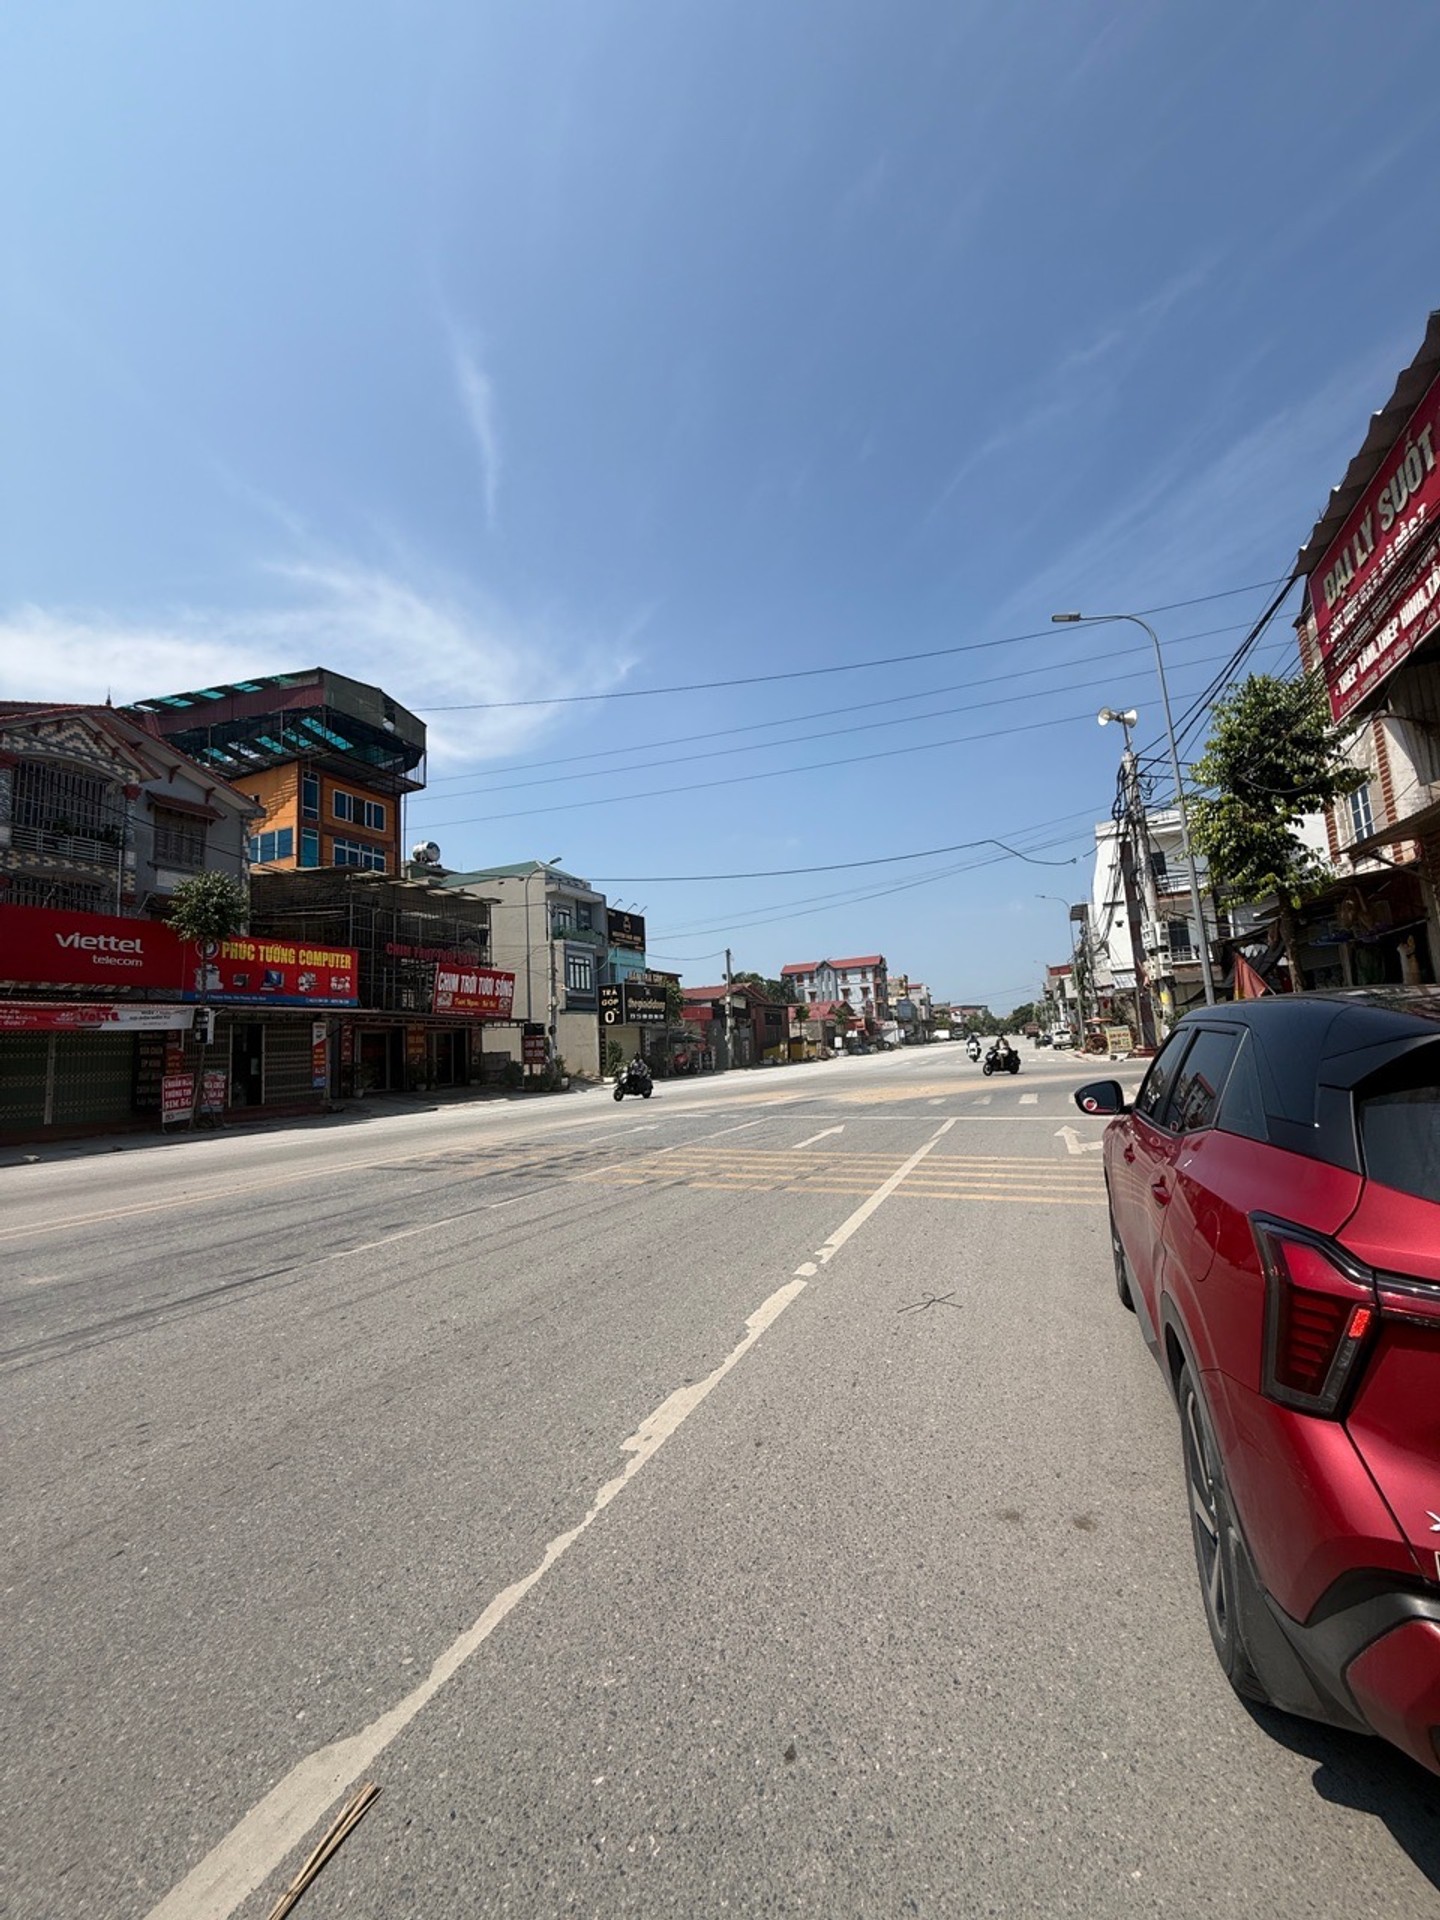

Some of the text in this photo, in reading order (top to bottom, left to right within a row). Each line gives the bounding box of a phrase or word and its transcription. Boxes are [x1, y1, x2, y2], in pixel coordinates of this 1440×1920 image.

[1378, 422, 1436, 531] SUỐT
[55, 932, 144, 954] viettel
[92, 954, 143, 967] telecom
[222, 940, 255, 961] PHÚC
[299, 949, 352, 969] COMPUTER
[438, 972, 459, 993] CHIM
[602, 986, 618, 996] TRẢ
[601, 997, 619, 1006] GÓP
